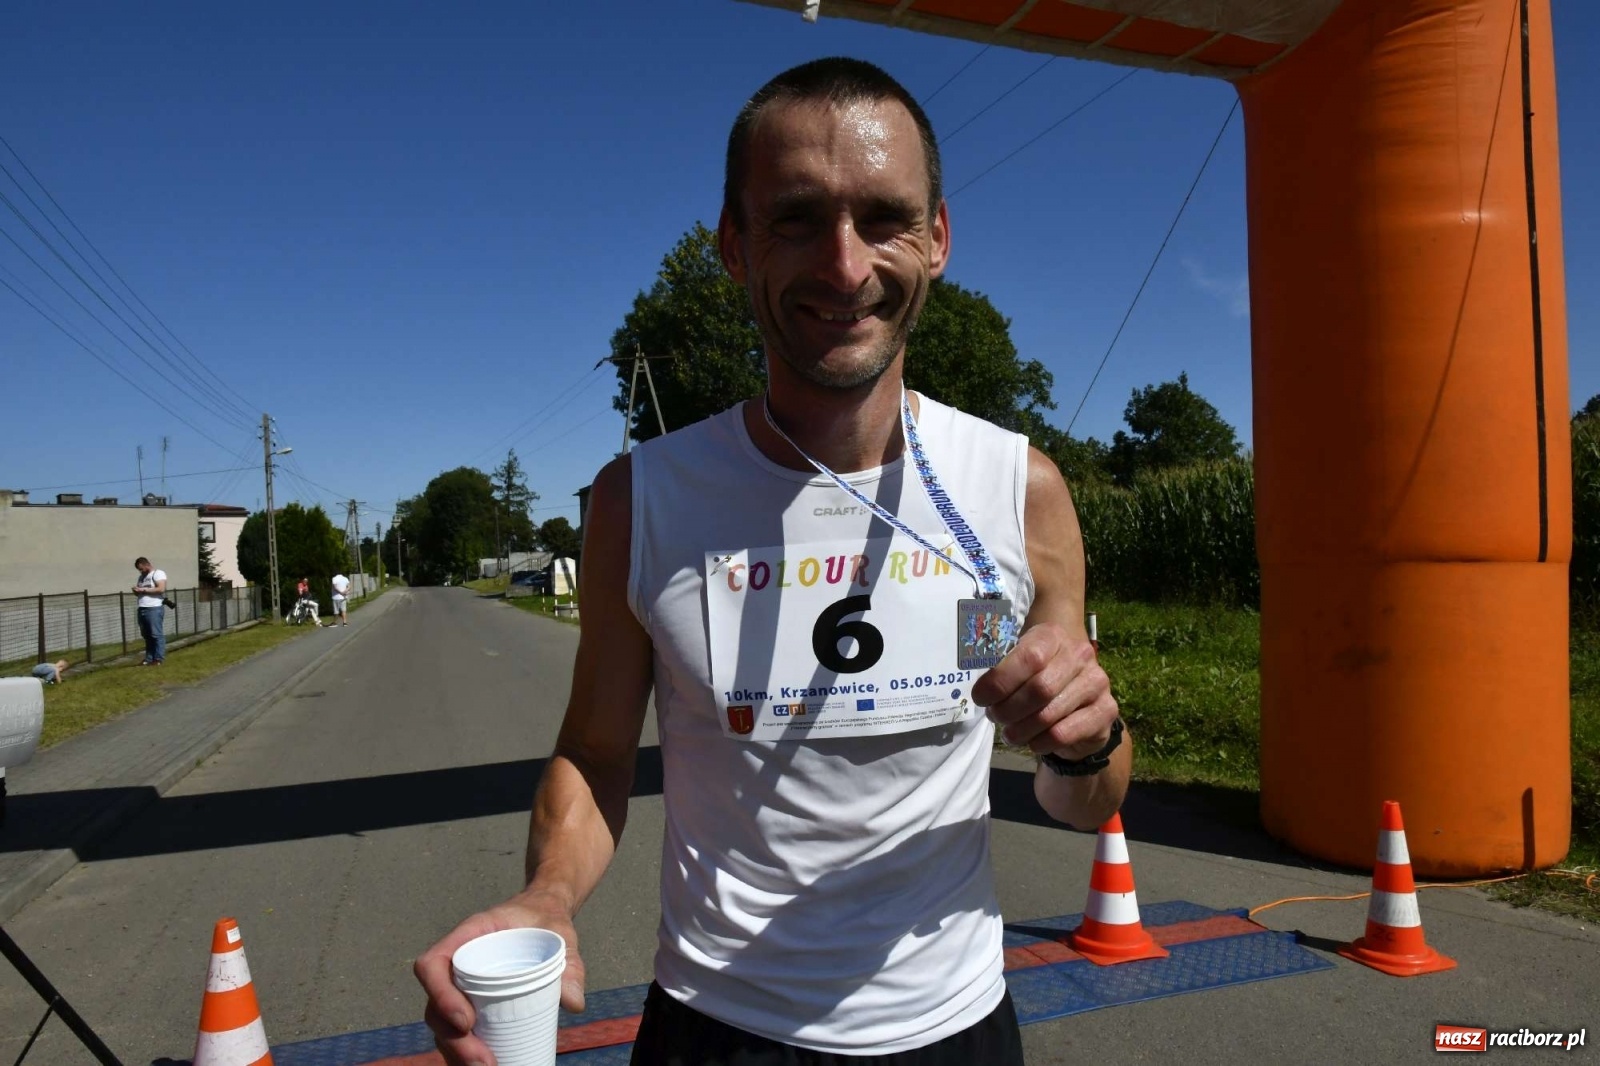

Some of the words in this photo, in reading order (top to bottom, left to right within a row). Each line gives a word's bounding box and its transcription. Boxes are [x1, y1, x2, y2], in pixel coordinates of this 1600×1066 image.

[813, 506, 857, 517] CRAFT
[727, 553, 870, 592] COLOUR
[889, 548, 953, 584] RUN
[812, 594, 884, 674] 6
[724, 688, 773, 702] 10km,
[780, 682, 880, 699] Krzanowice,
[890, 670, 971, 690] 05.09.2021
